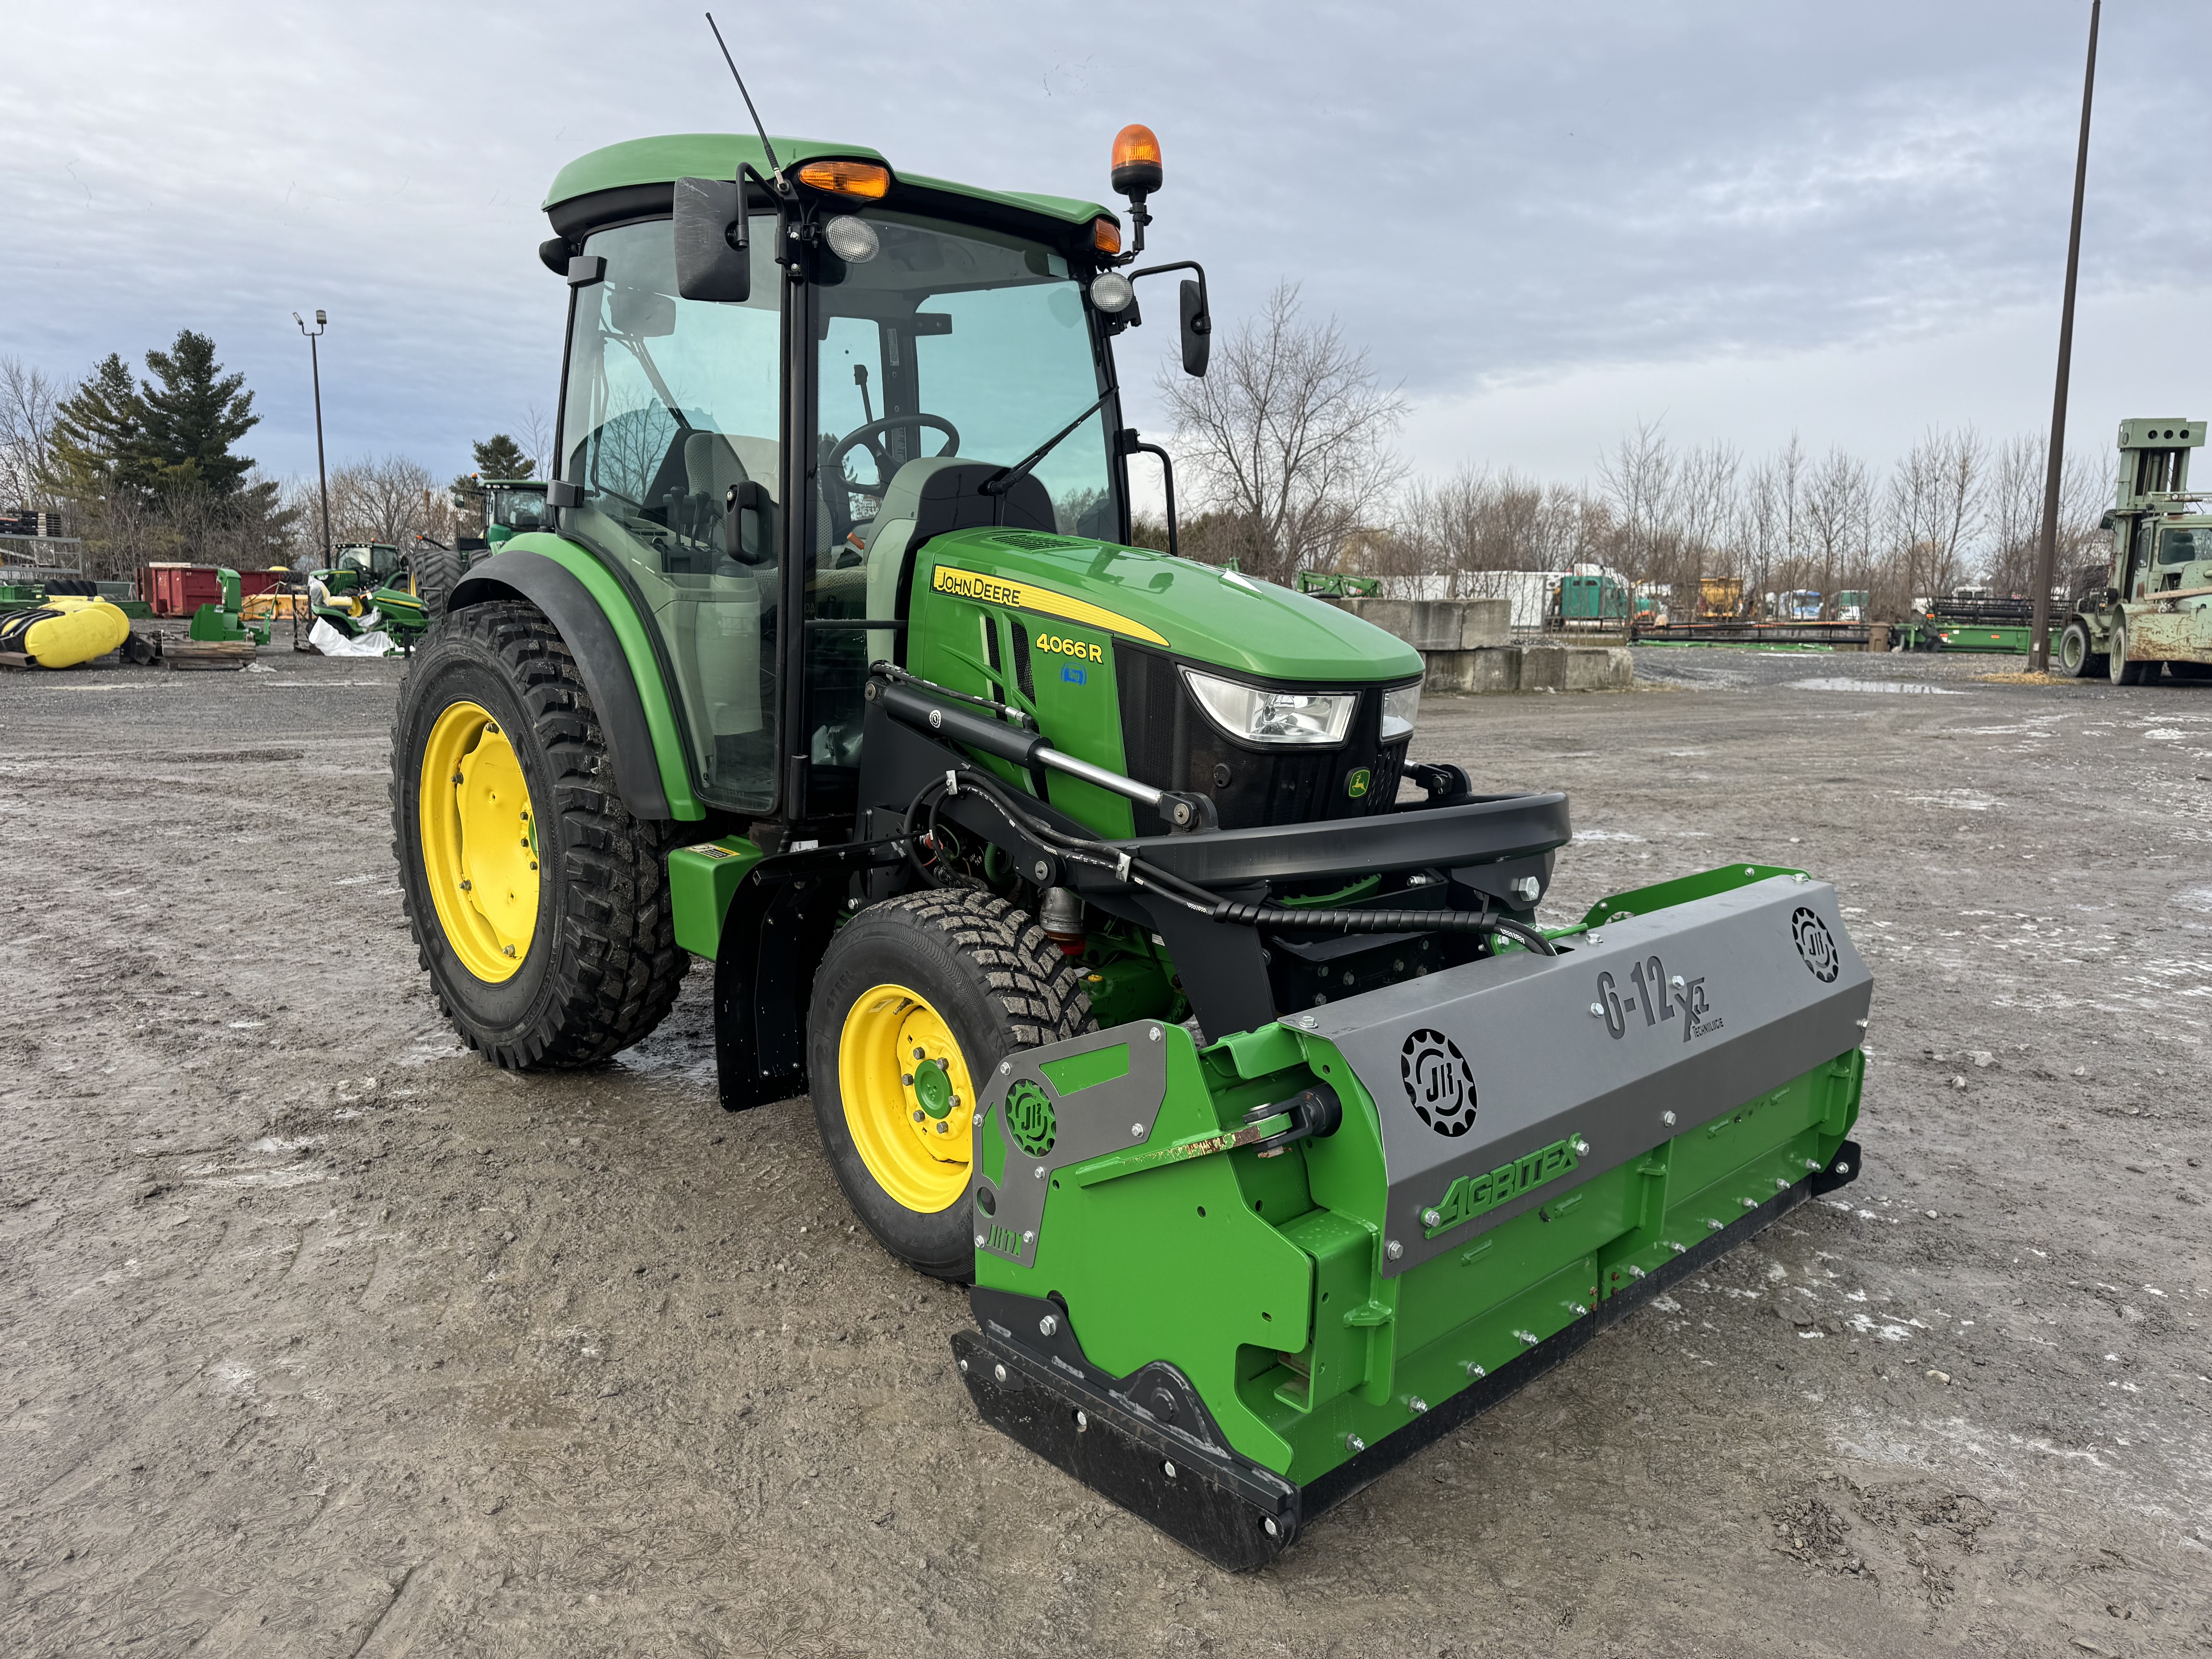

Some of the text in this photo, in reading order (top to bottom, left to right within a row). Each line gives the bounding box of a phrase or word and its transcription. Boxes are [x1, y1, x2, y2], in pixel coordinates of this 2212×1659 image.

[938, 572, 1021, 605] JOHN DEERE
[1036, 633, 1103, 664] 4066R
[826, 969, 855, 1011] STEEL
[1597, 955, 1675, 1040] 6-12
[1426, 1062, 1454, 1102] JR
[1021, 1103, 1041, 1132] JR
[1424, 1132, 1581, 1240] AGRITEX
